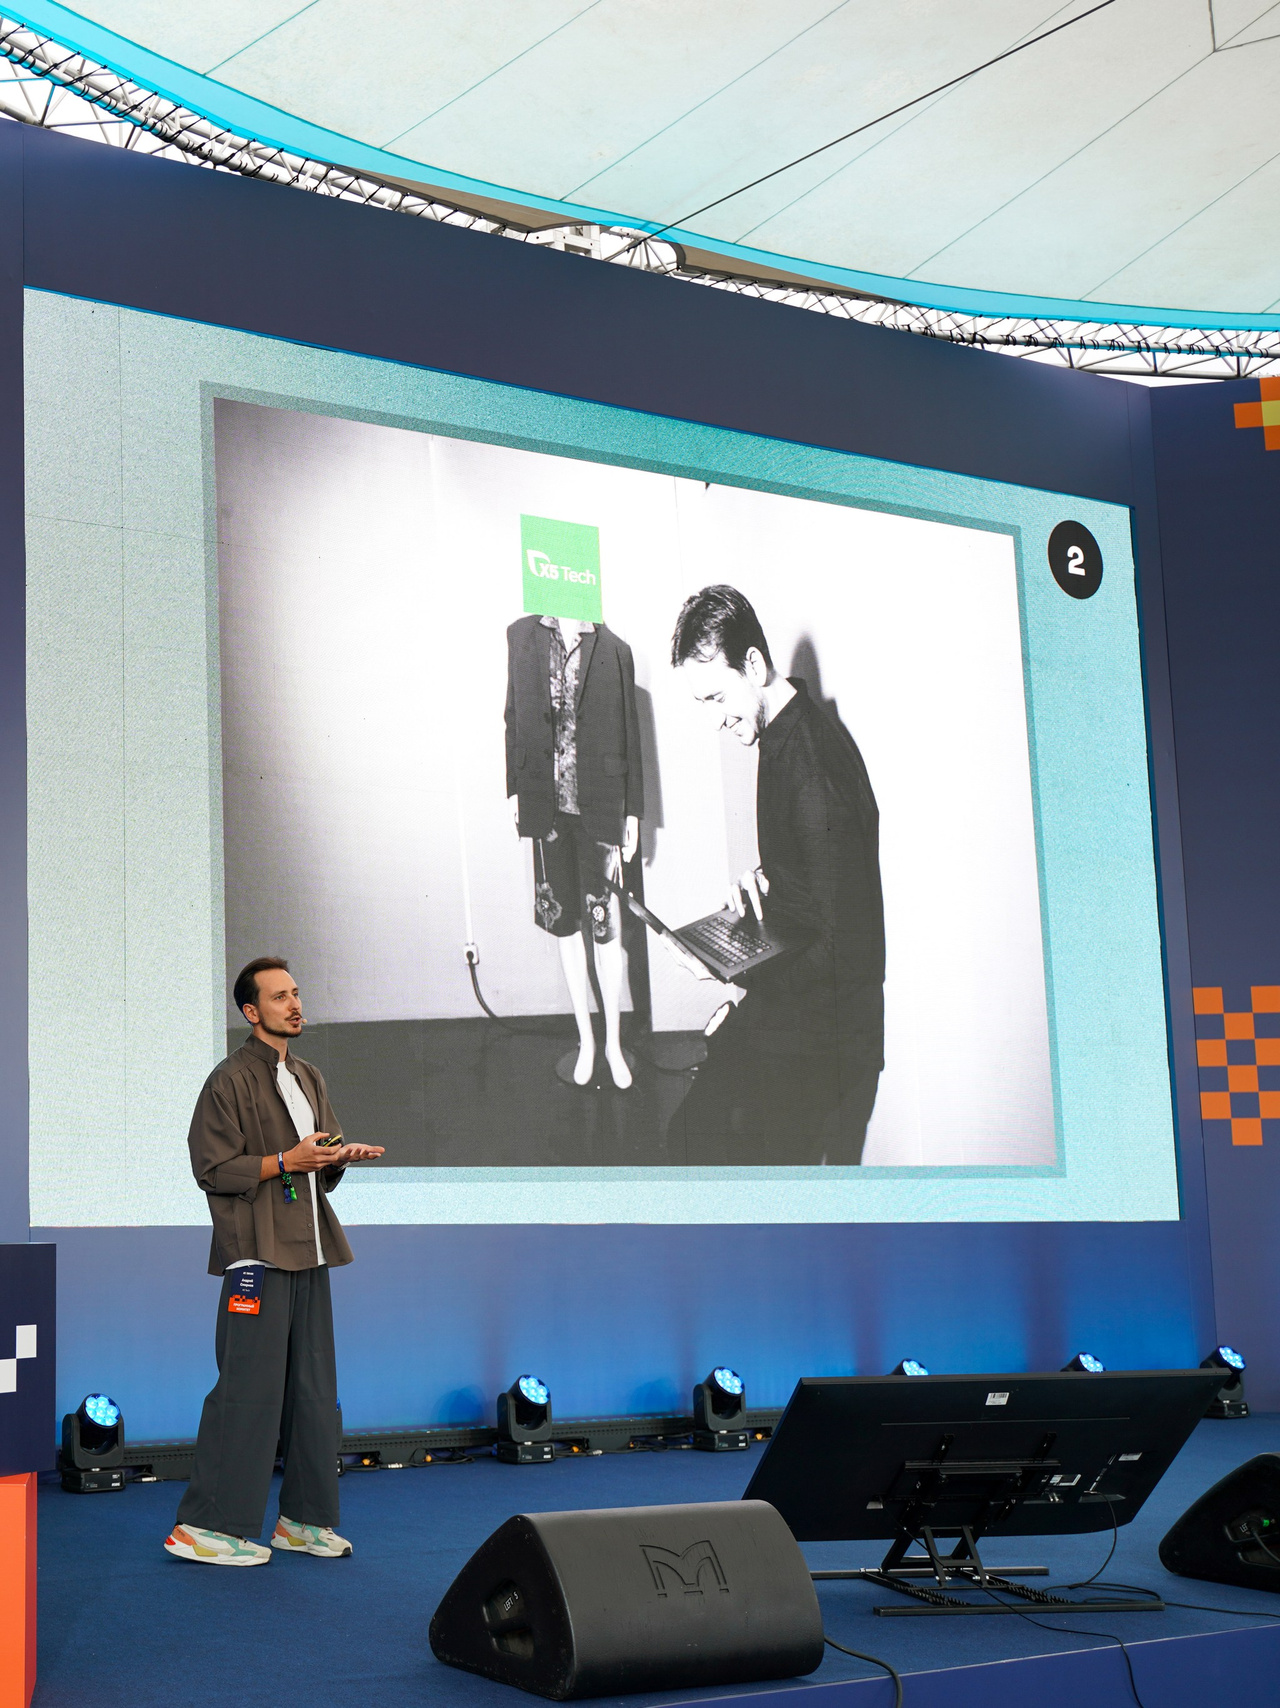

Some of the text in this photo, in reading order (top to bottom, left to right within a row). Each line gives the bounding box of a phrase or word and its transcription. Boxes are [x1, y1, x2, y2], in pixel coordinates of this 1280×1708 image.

[1067, 545, 1086, 576] 2
[539, 562, 596, 585] X5 Tech
[503, 1597, 513, 1611] LEFT
